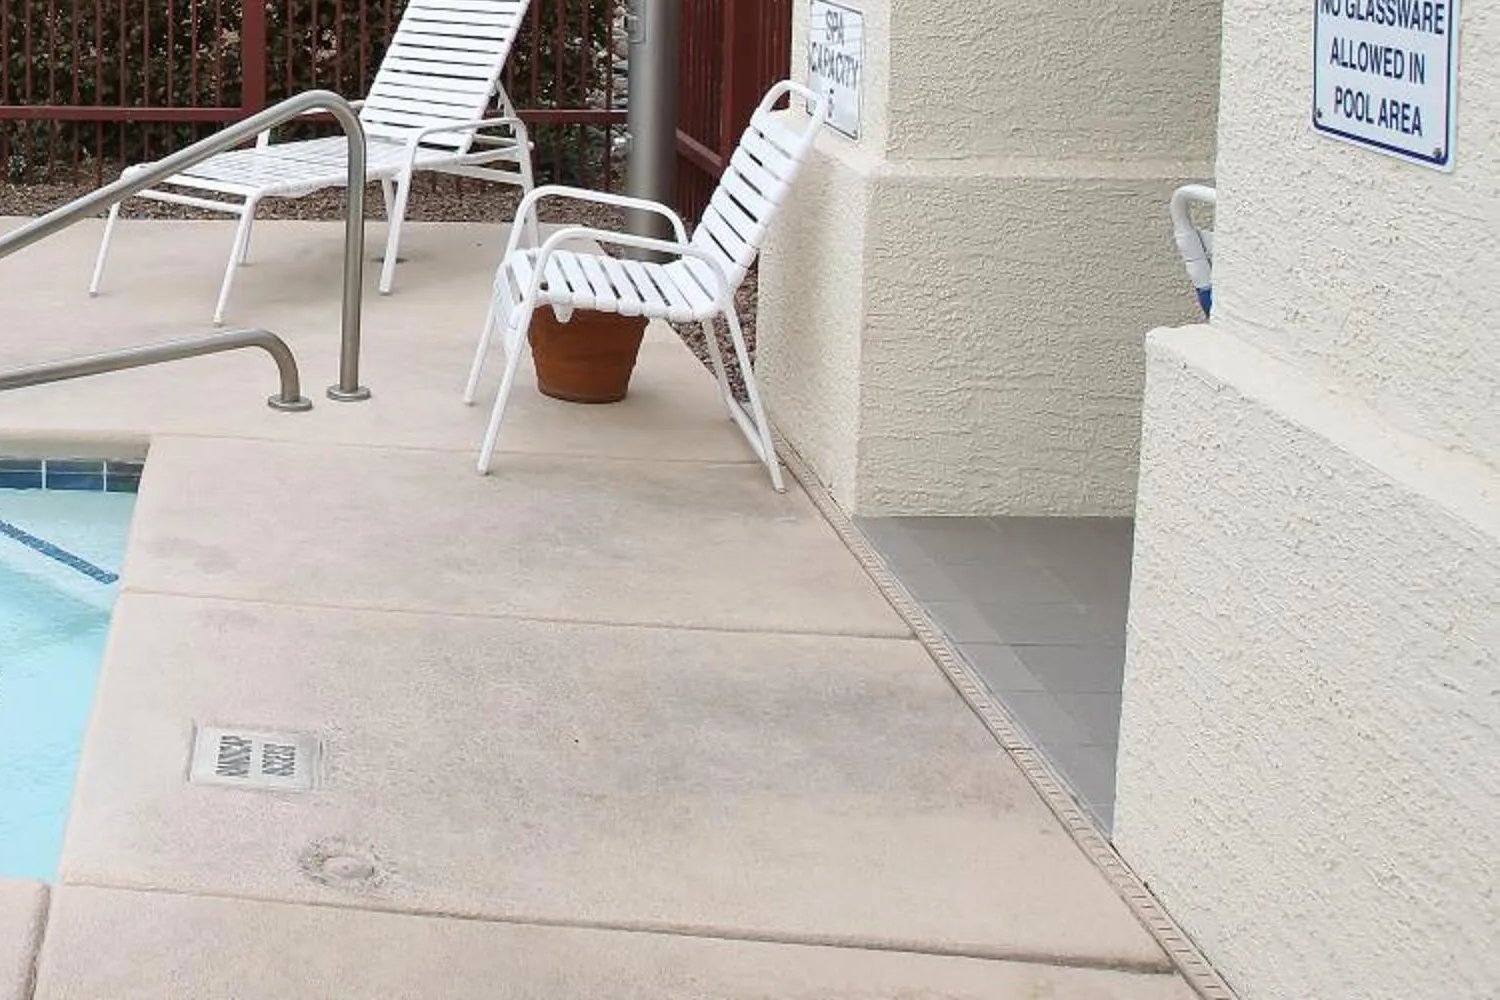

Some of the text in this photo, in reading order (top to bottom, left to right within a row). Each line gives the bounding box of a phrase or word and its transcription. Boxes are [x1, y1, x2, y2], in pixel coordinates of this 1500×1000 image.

[825, 7, 845, 47] SPA
[808, 40, 859, 91] CAPACITY
[1329, 36, 1425, 85] ALLOWED IN
[1333, 85, 1423, 138] POOL AREA
